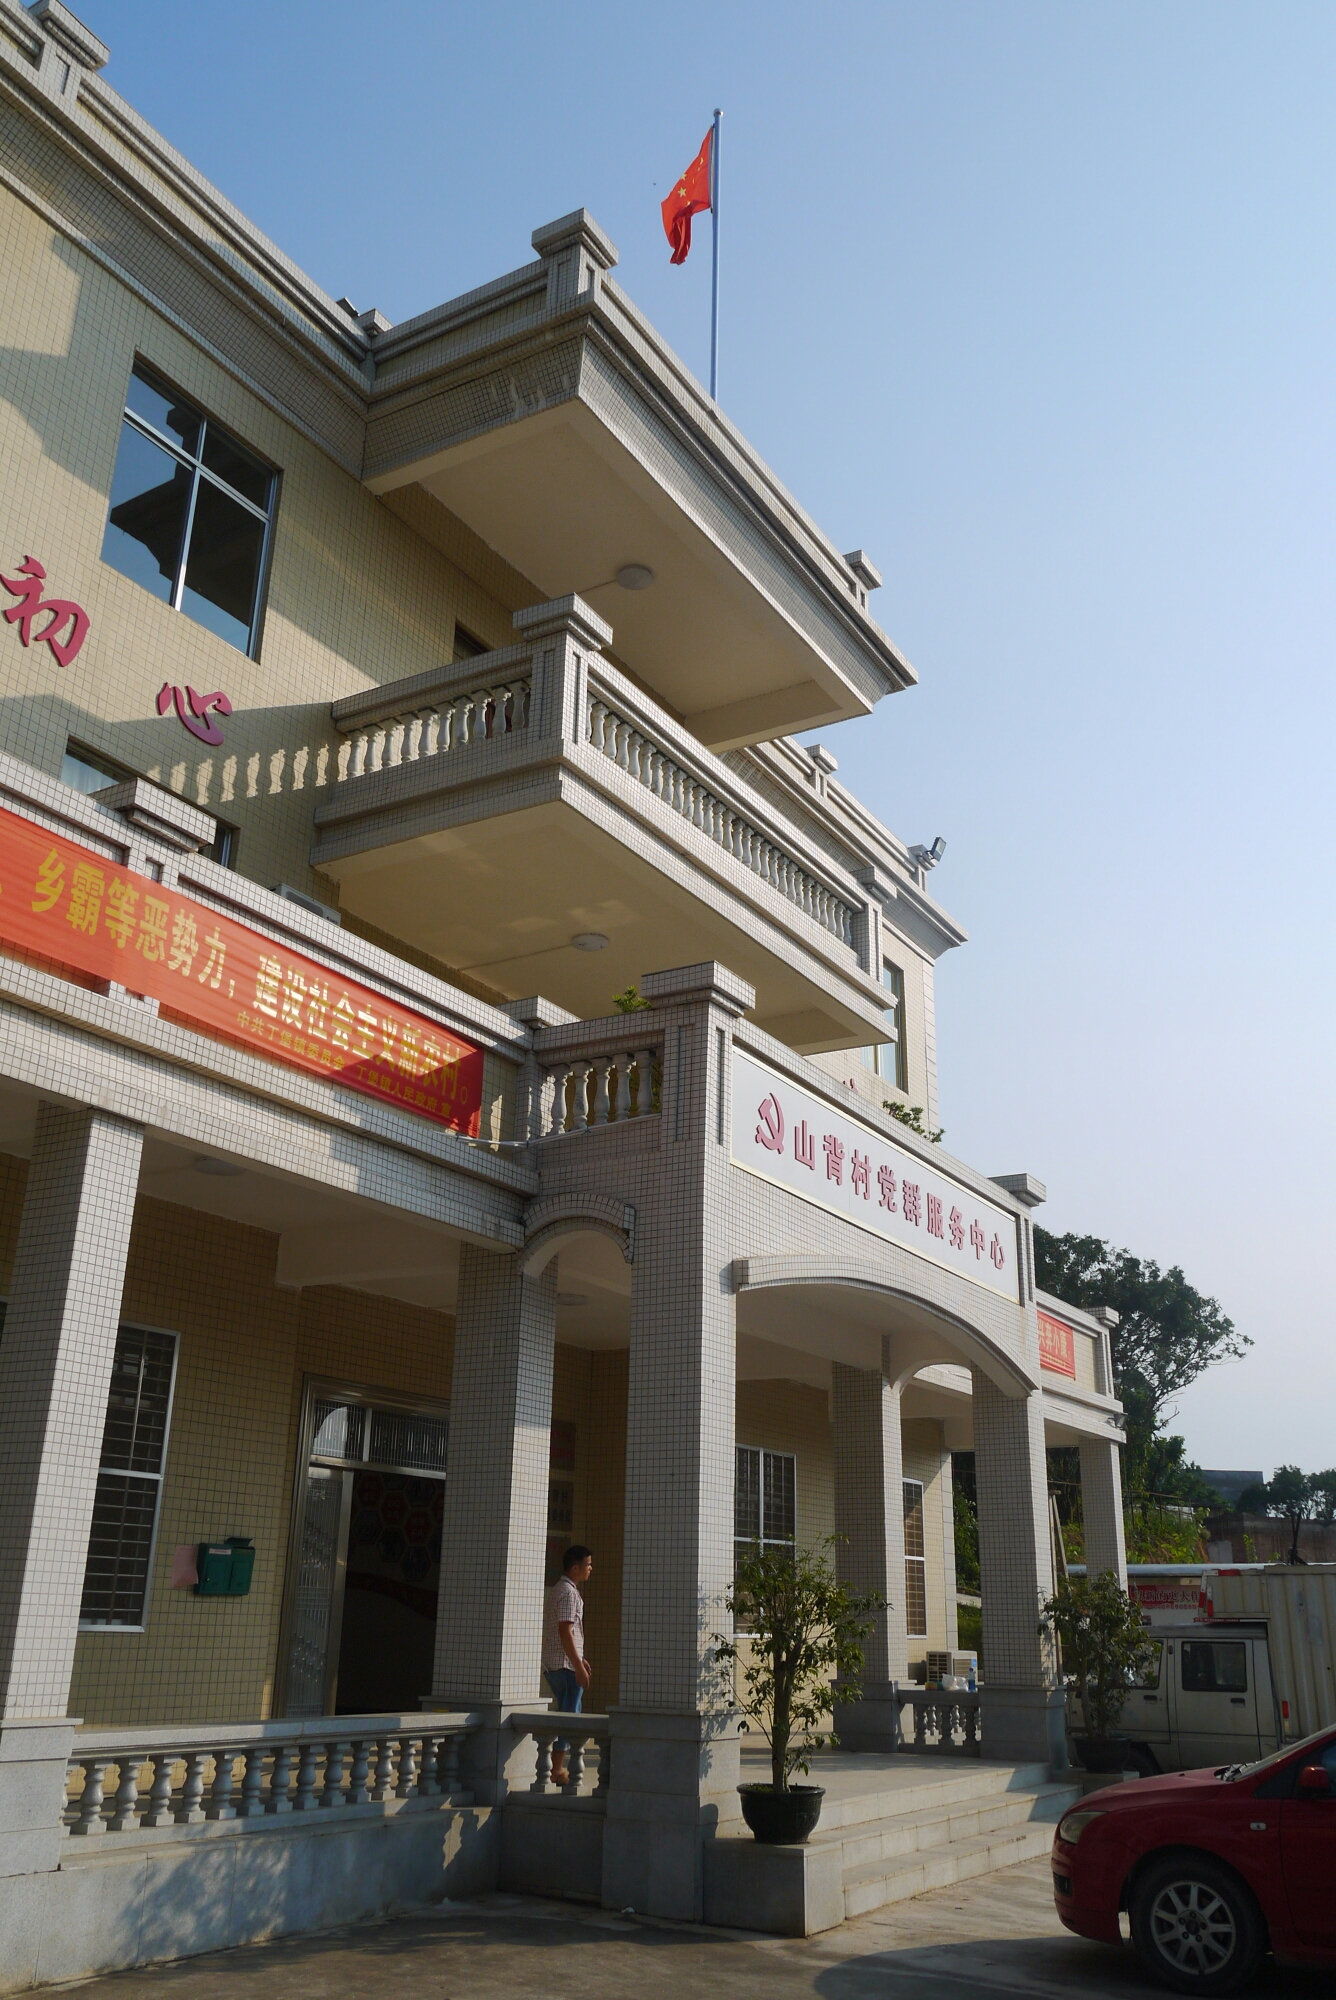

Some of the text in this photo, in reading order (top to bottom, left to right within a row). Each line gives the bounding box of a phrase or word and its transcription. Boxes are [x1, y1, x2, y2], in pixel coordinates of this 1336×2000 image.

[0, 848, 468, 1105] 乡霸等恶势力，建设社会主义新农村。
[237, 1011, 346, 1071] 中共丁堡镇委员会
[794, 1119, 1005, 1270] 山背村党群服务中心
